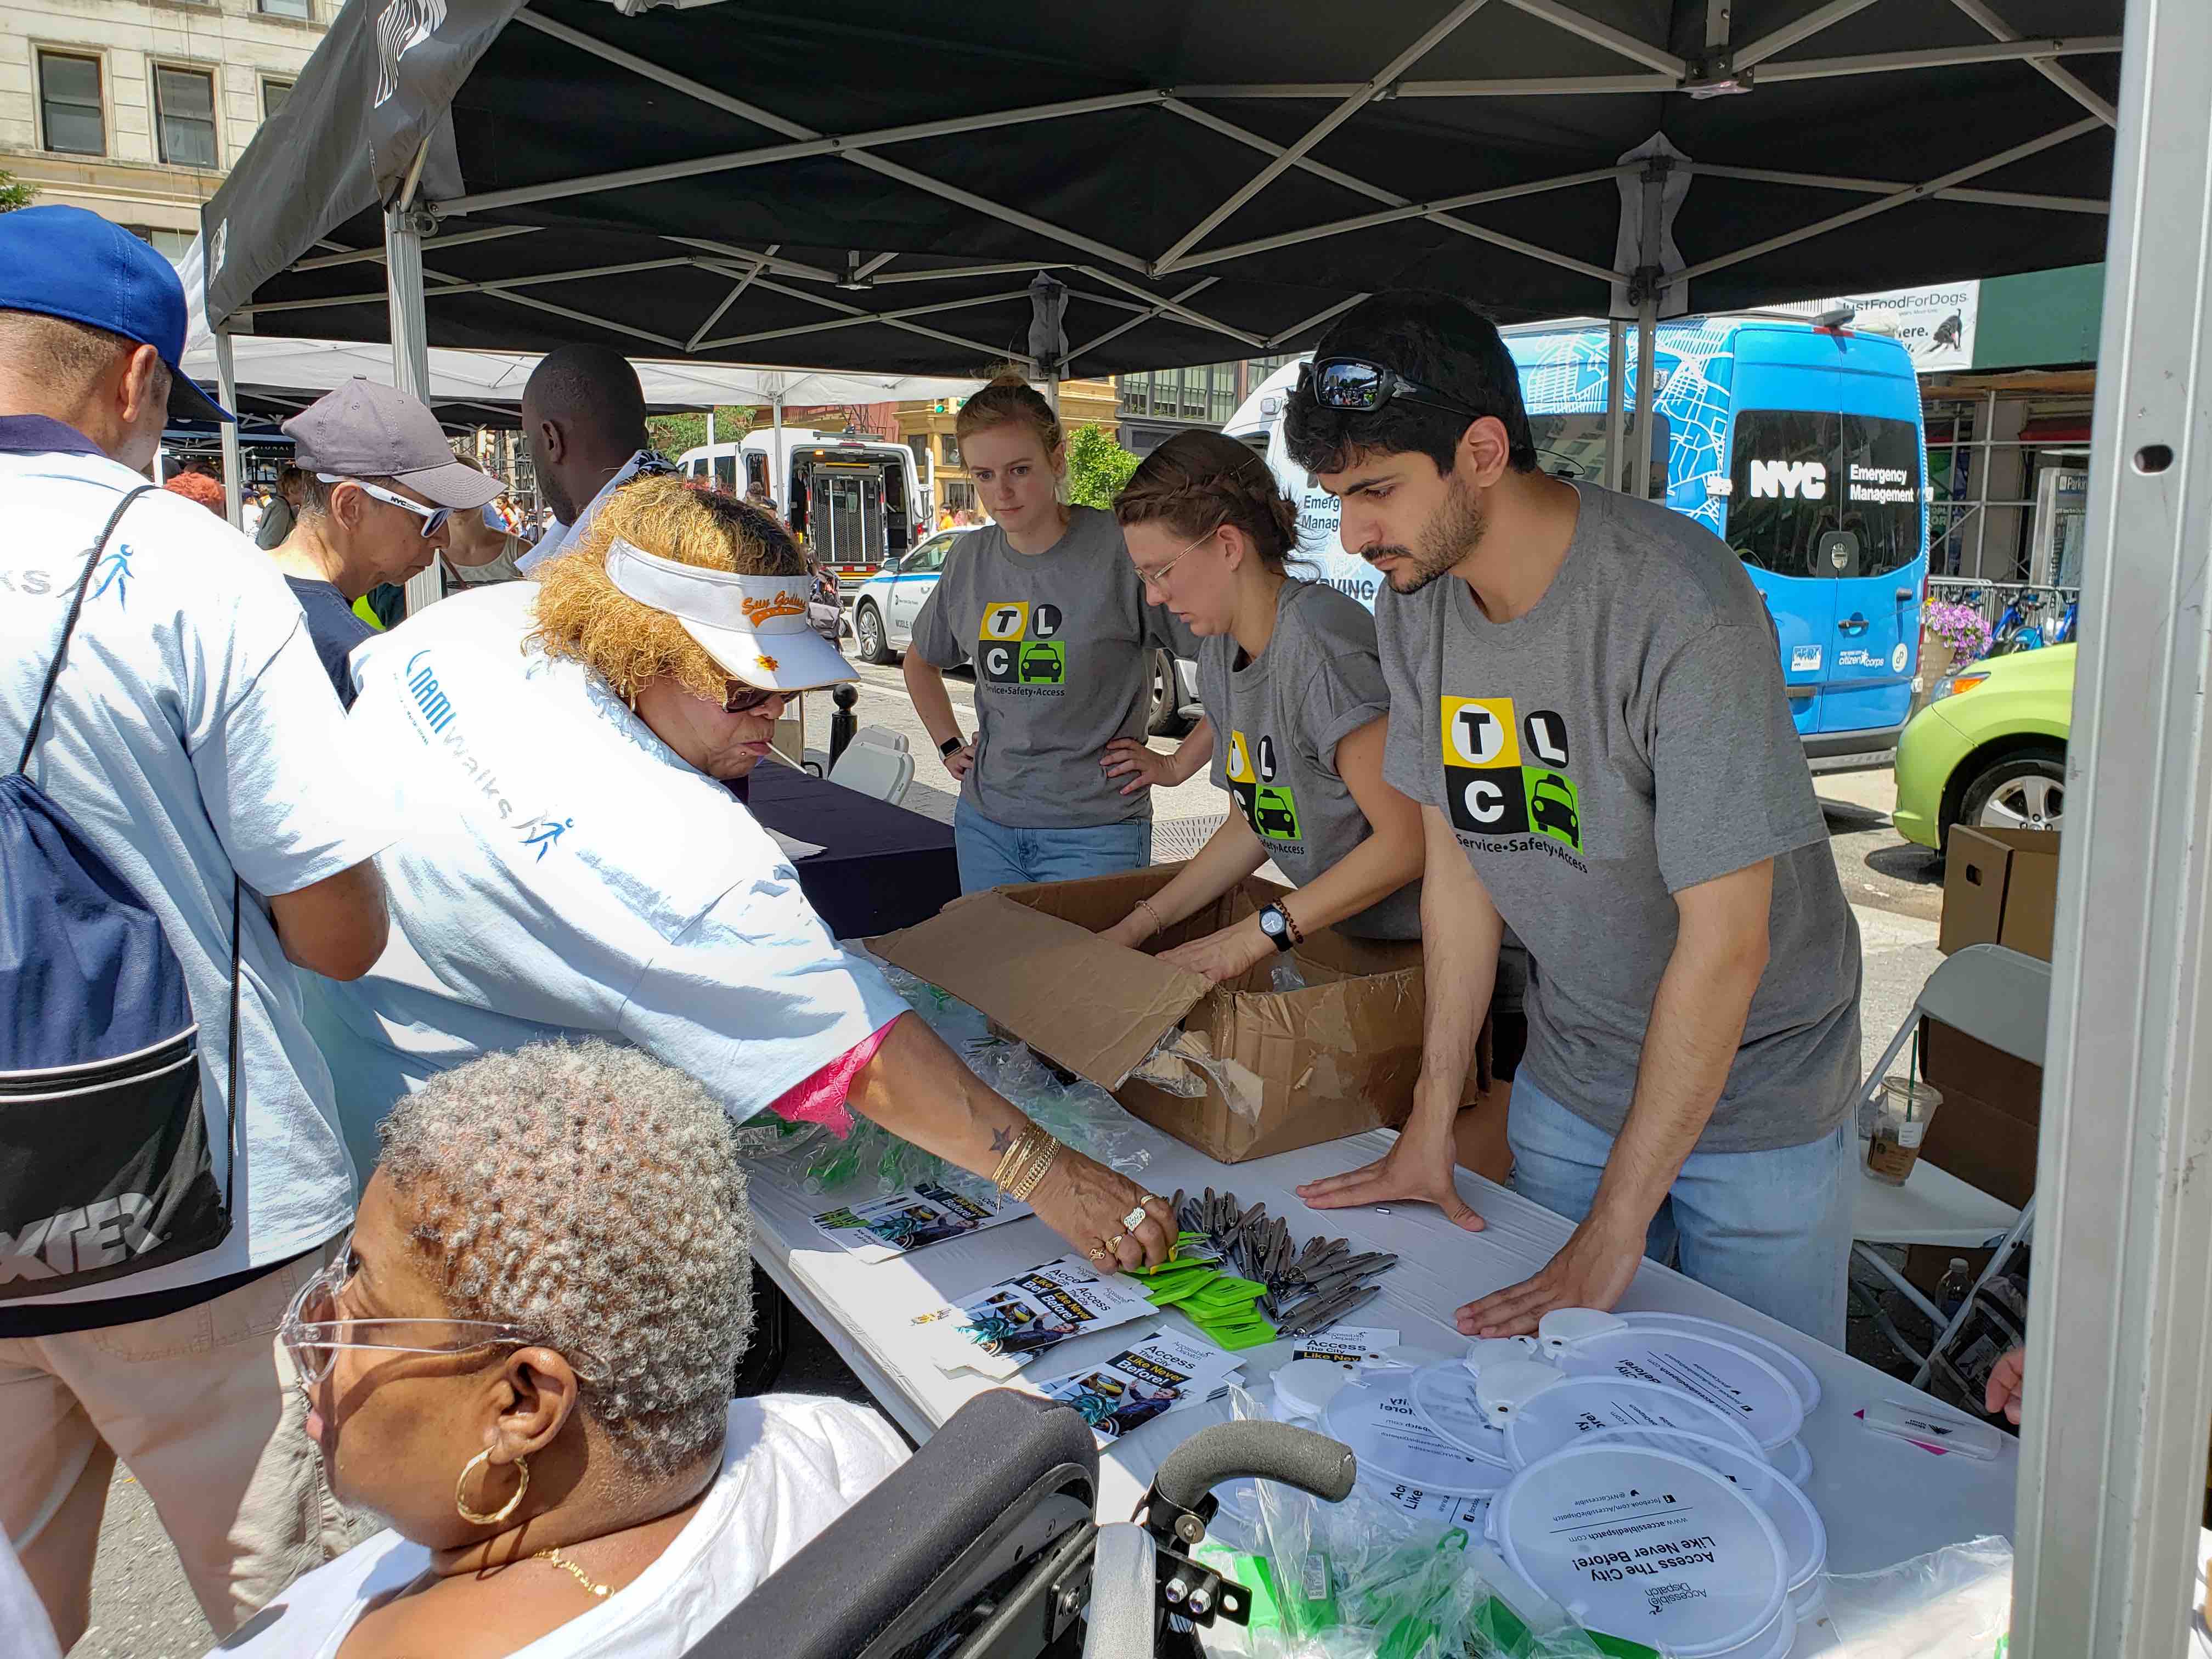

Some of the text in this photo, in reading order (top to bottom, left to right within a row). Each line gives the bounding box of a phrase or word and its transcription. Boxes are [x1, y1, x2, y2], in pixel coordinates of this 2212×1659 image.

[1898, 327, 1928, 338] ere.
[1750, 459, 1826, 499] NYC
[1850, 464, 1908, 485] Emergency
[2067, 476, 2087, 489] Parkin
[390, 496, 407, 506] NYC
[1304, 495, 1340, 512] Emerg
[1849, 484, 1914, 504] Management
[1301, 515, 1339, 532] Manag
[741, 596, 770, 615] Sun
[996, 608, 1053, 635] T L
[987, 648, 1009, 675] C
[1838, 654, 1884, 668] citizen corps
[1458, 711, 1567, 764] T L
[1261, 741, 1273, 777] L
[1465, 780, 1504, 823] C
[941, 1198, 977, 1221] Before!
[0, 1192, 163, 1285] XTER
[1031, 1276, 1054, 1288] Like
[1049, 1268, 1081, 1284] Acce
[1057, 1278, 1070, 1287] Cit
[1068, 1289, 1079, 1298] The
[1076, 1286, 1111, 1312] Access
[1041, 1295, 1080, 1321] Before!
[1054, 1291, 1093, 1320] Like Never
[1307, 1339, 1367, 1352] Access
[1126, 1354, 1186, 1382] Like Never
[1138, 1350, 1172, 1367] The City
[1144, 1345, 1196, 1370] Access
[1115, 1359, 1170, 1385] Before!
[1403, 1489, 1423, 1510] Like
[1568, 1517, 1689, 1543] www.accessibledispatch.com
[1572, 1536, 1717, 1571] Like Never Before!
[1590, 1551, 1716, 1582] Access The City
[1645, 1582, 1691, 1597] Dispatch
[1650, 1588, 1708, 1606] Accessible
